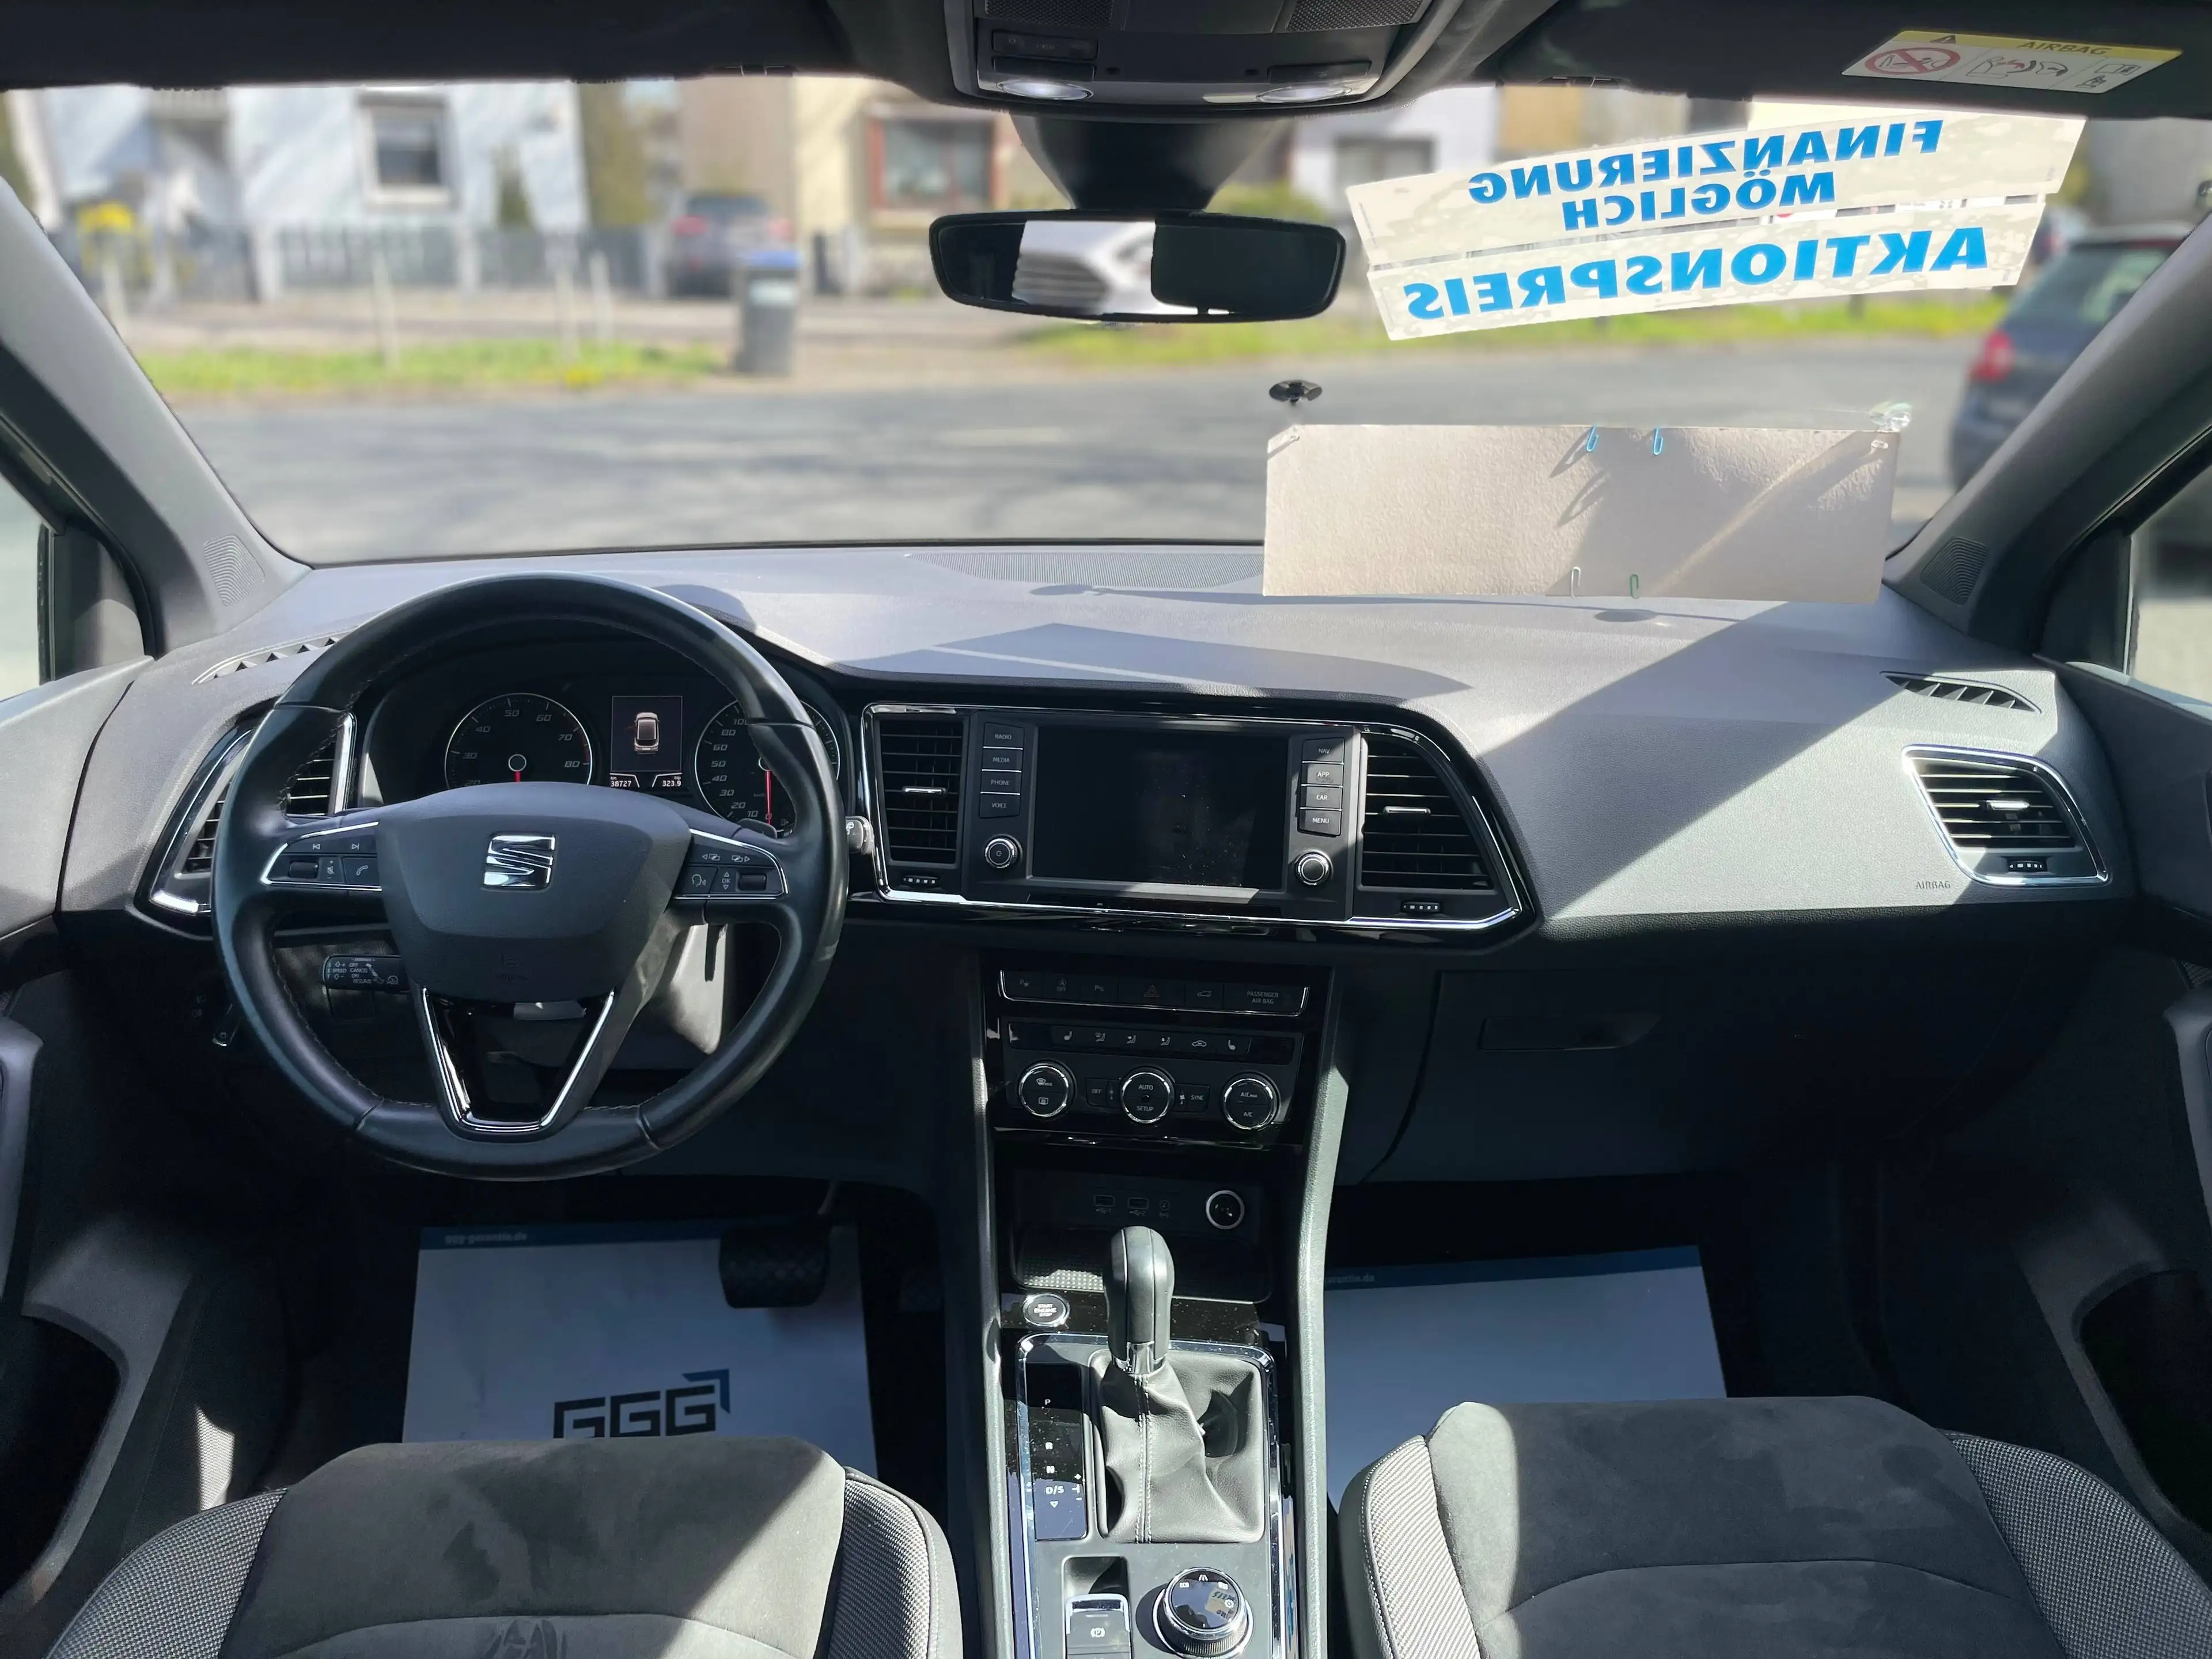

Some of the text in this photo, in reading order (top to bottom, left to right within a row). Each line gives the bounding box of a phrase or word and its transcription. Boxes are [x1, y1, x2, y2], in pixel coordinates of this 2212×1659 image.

[2016, 40, 2112, 55] AIRBAG
[536, 714, 552, 722] 60
[558, 733, 573, 741] 70
[564, 760, 580, 768] 80
[1916, 881, 1951, 889] AIRBAG
[1247, 990, 1279, 998] PASSENGER
[554, 1384, 715, 1439] GGG
[1046, 1465, 1055, 1474] N
[1045, 1485, 1064, 1495] D/S
